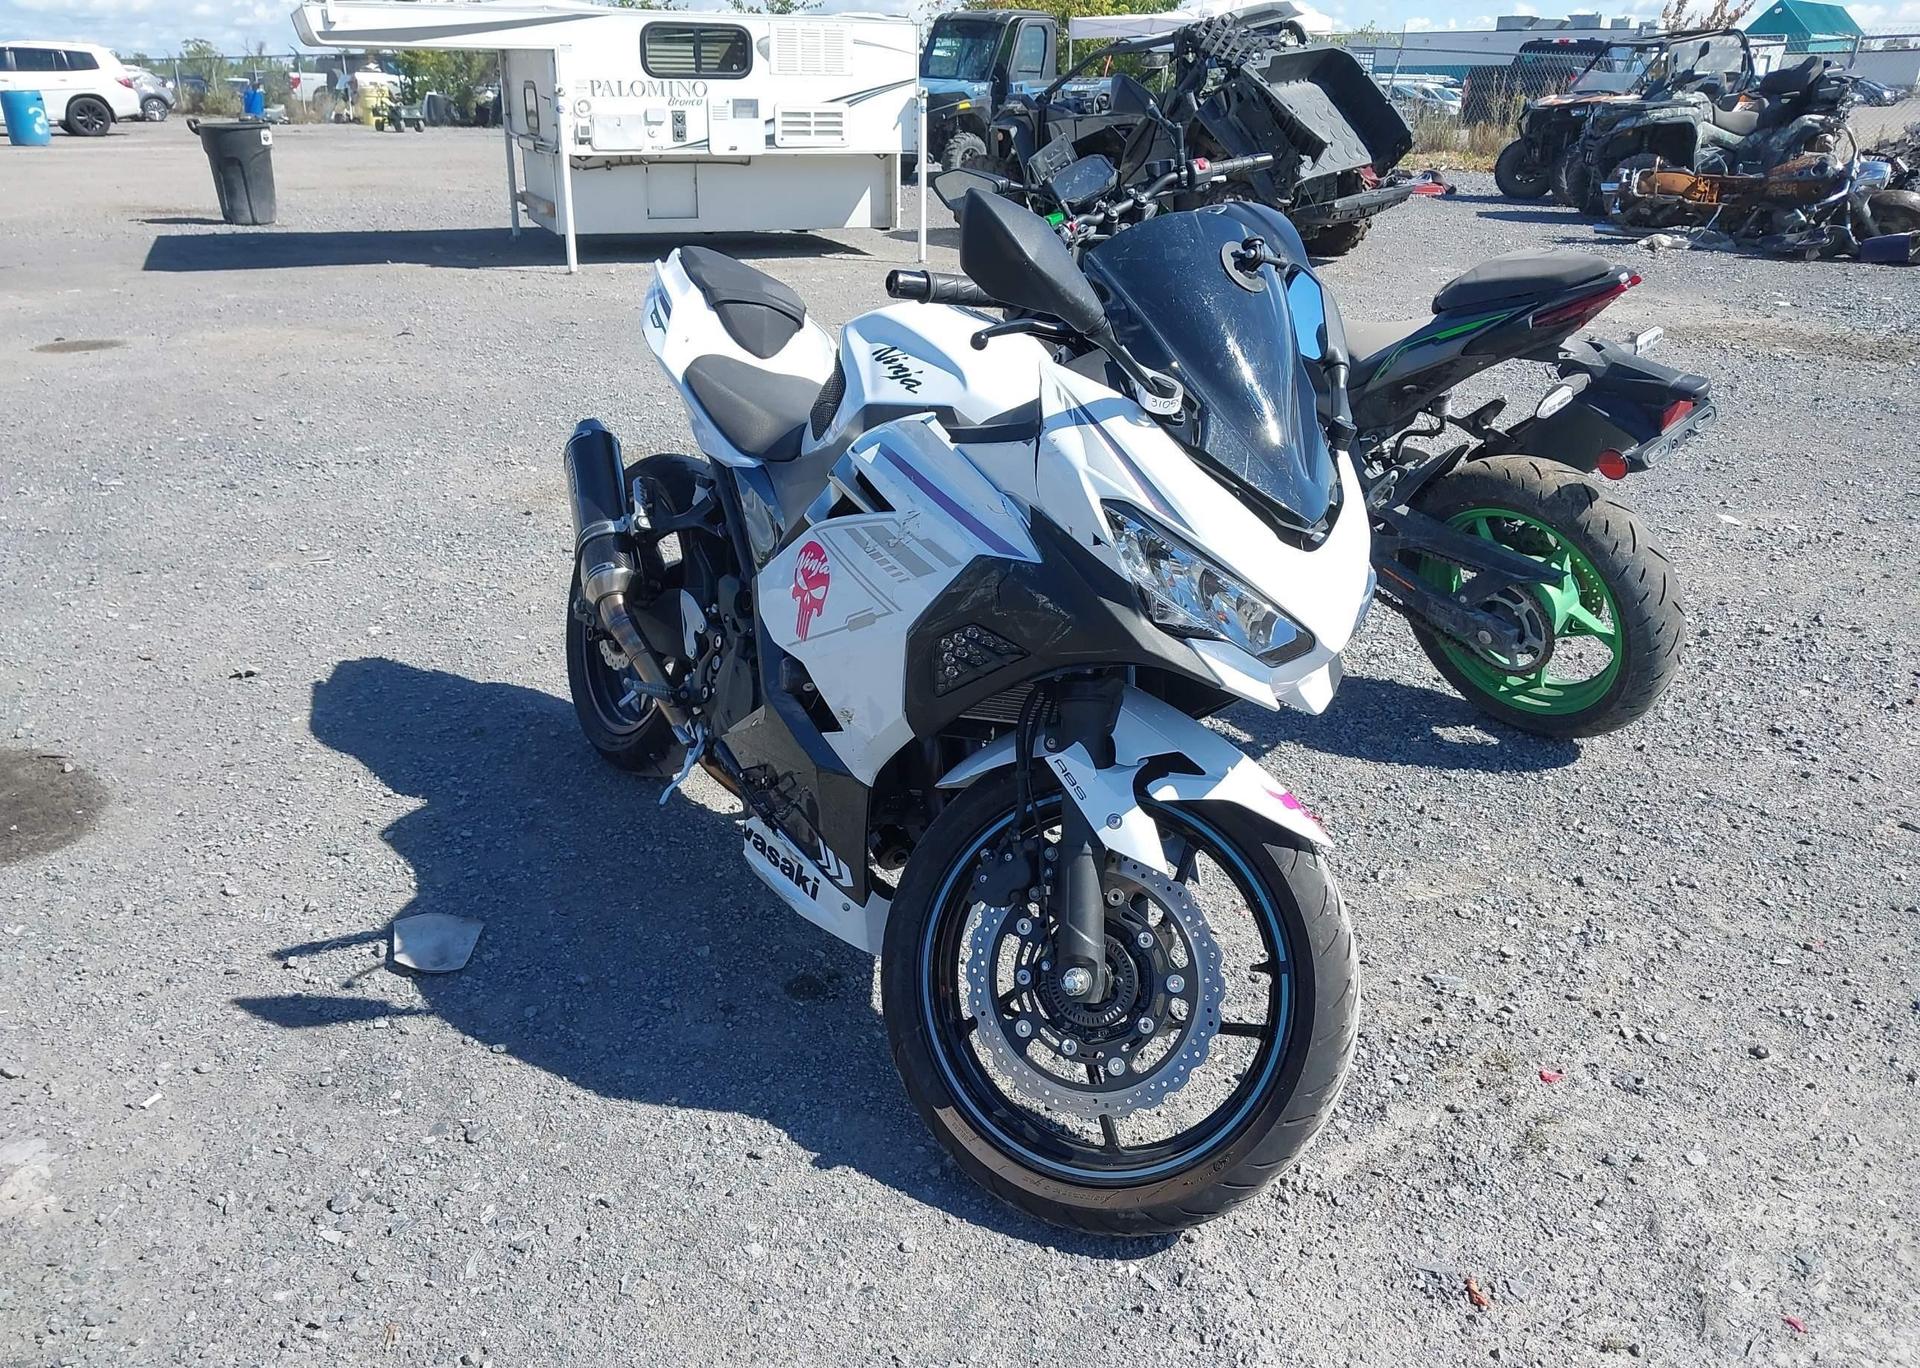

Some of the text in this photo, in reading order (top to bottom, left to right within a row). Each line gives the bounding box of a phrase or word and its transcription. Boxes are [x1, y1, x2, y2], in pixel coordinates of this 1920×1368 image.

[589, 80, 708, 97] PALOMINO
[667, 95, 703, 107] Bronco
[872, 346, 923, 394] Ninja
[797, 551, 830, 580] Ninja
[1054, 759, 1087, 800] ABS
